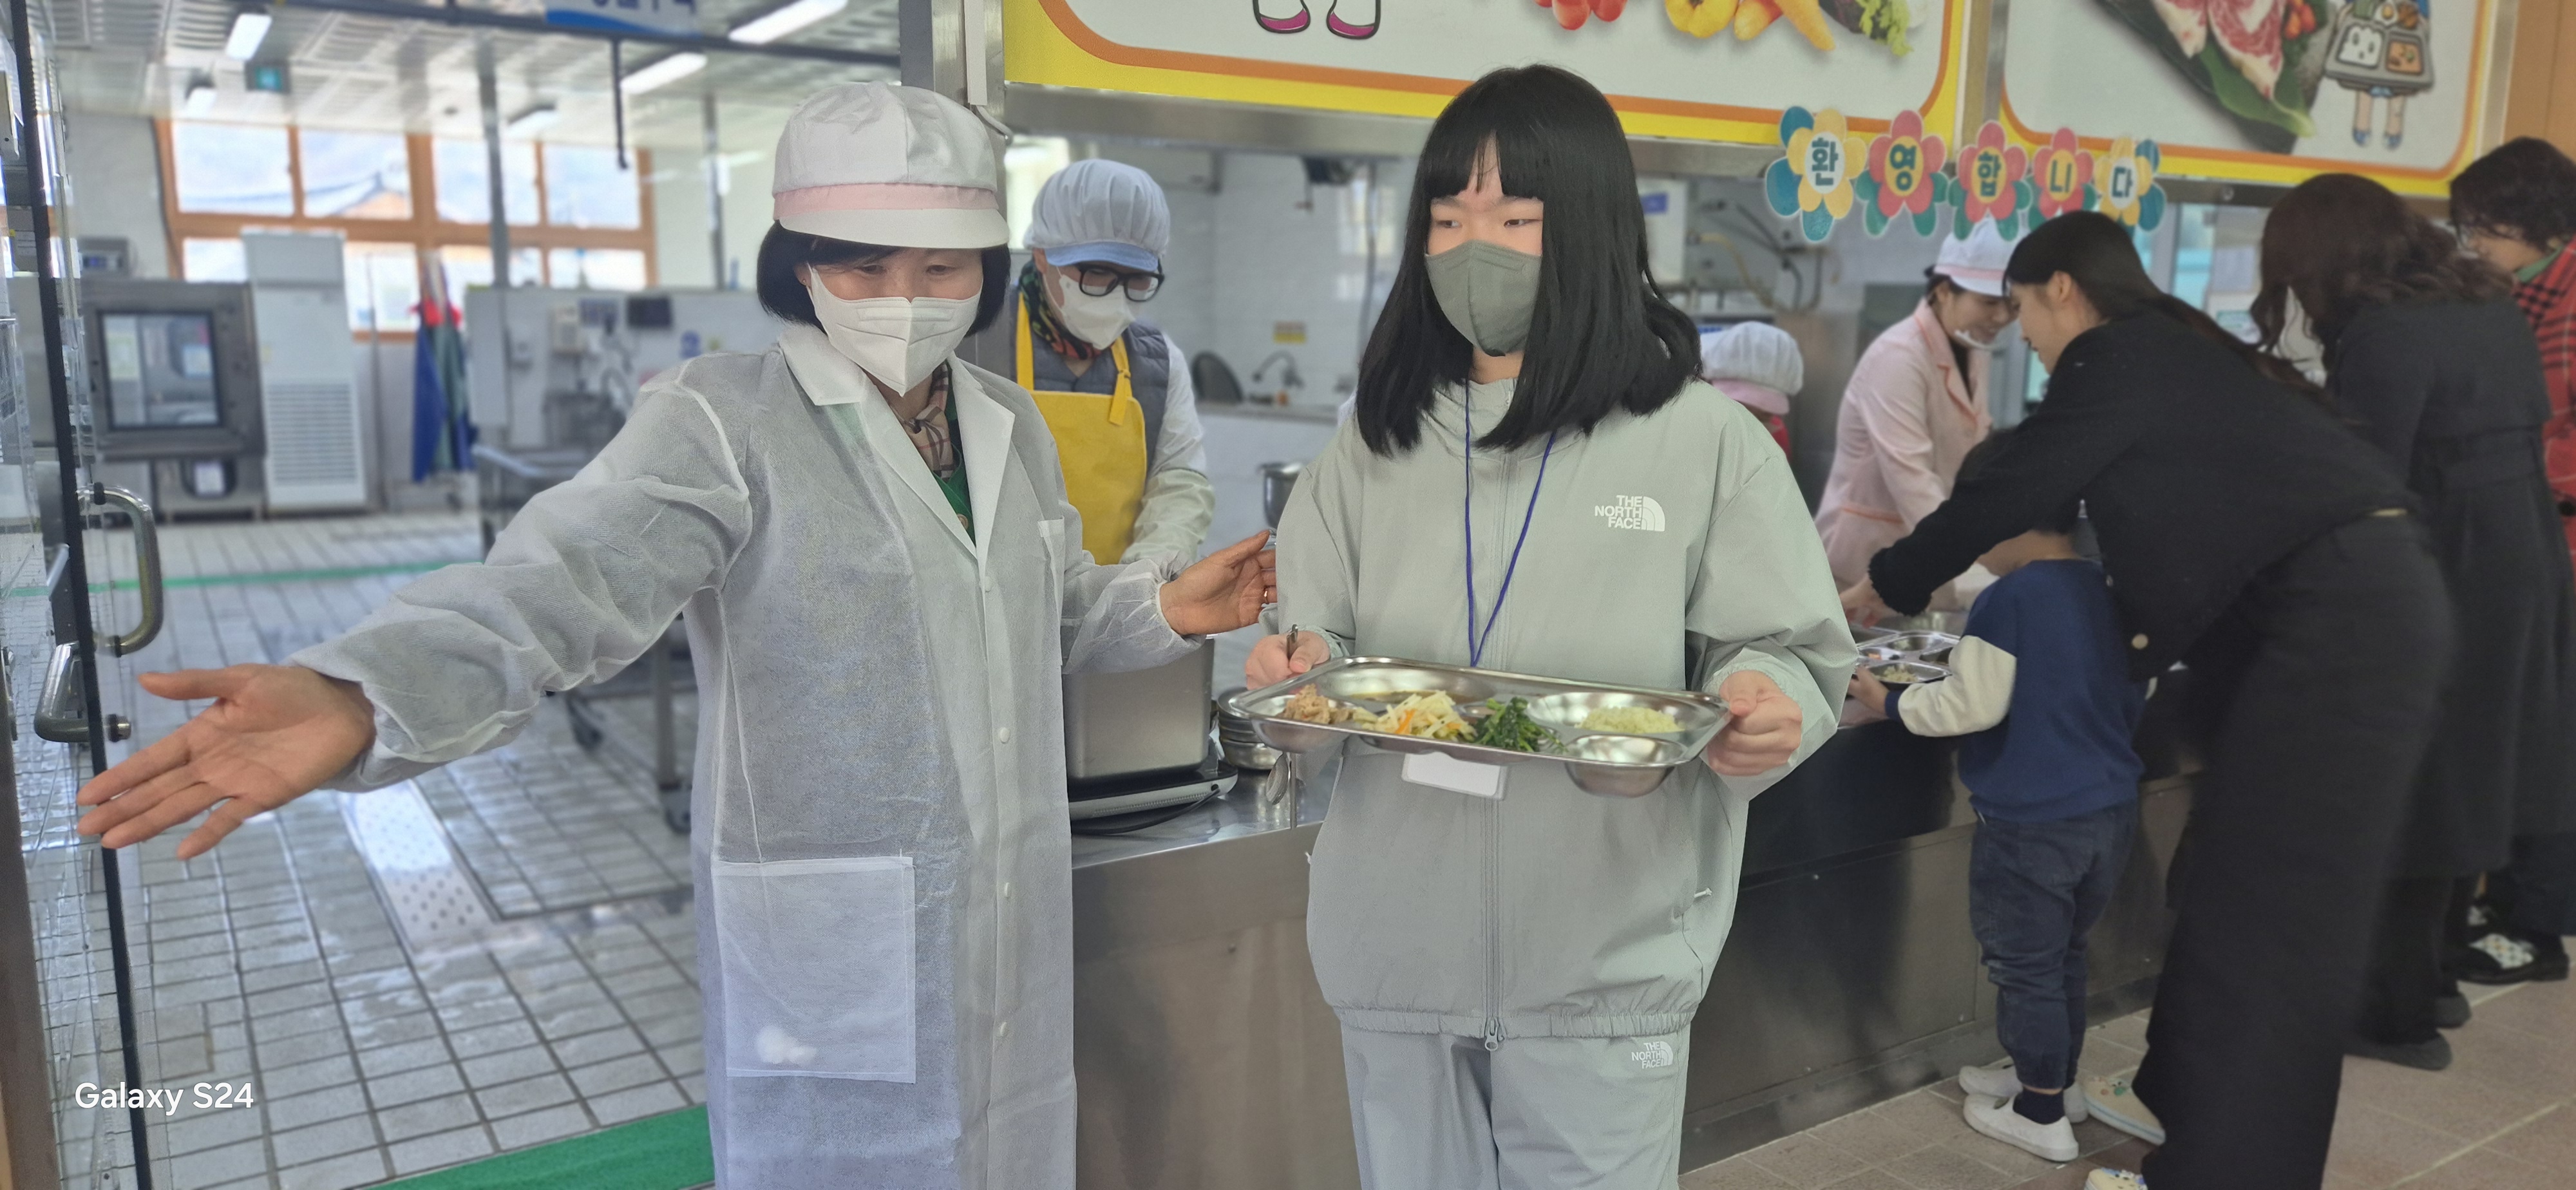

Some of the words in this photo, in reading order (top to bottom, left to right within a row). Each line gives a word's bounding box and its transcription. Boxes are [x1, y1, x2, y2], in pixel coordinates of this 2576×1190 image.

[1811, 137, 2133, 198] 환영합니다
[1616, 495, 1643, 507] THE
[1595, 505, 1642, 518] NORTH
[1608, 516, 1642, 529] FACE
[1643, 1041, 1660, 1051] THE
[1631, 1050, 1661, 1061] NORTH
[1642, 1059, 1661, 1069] FACE
